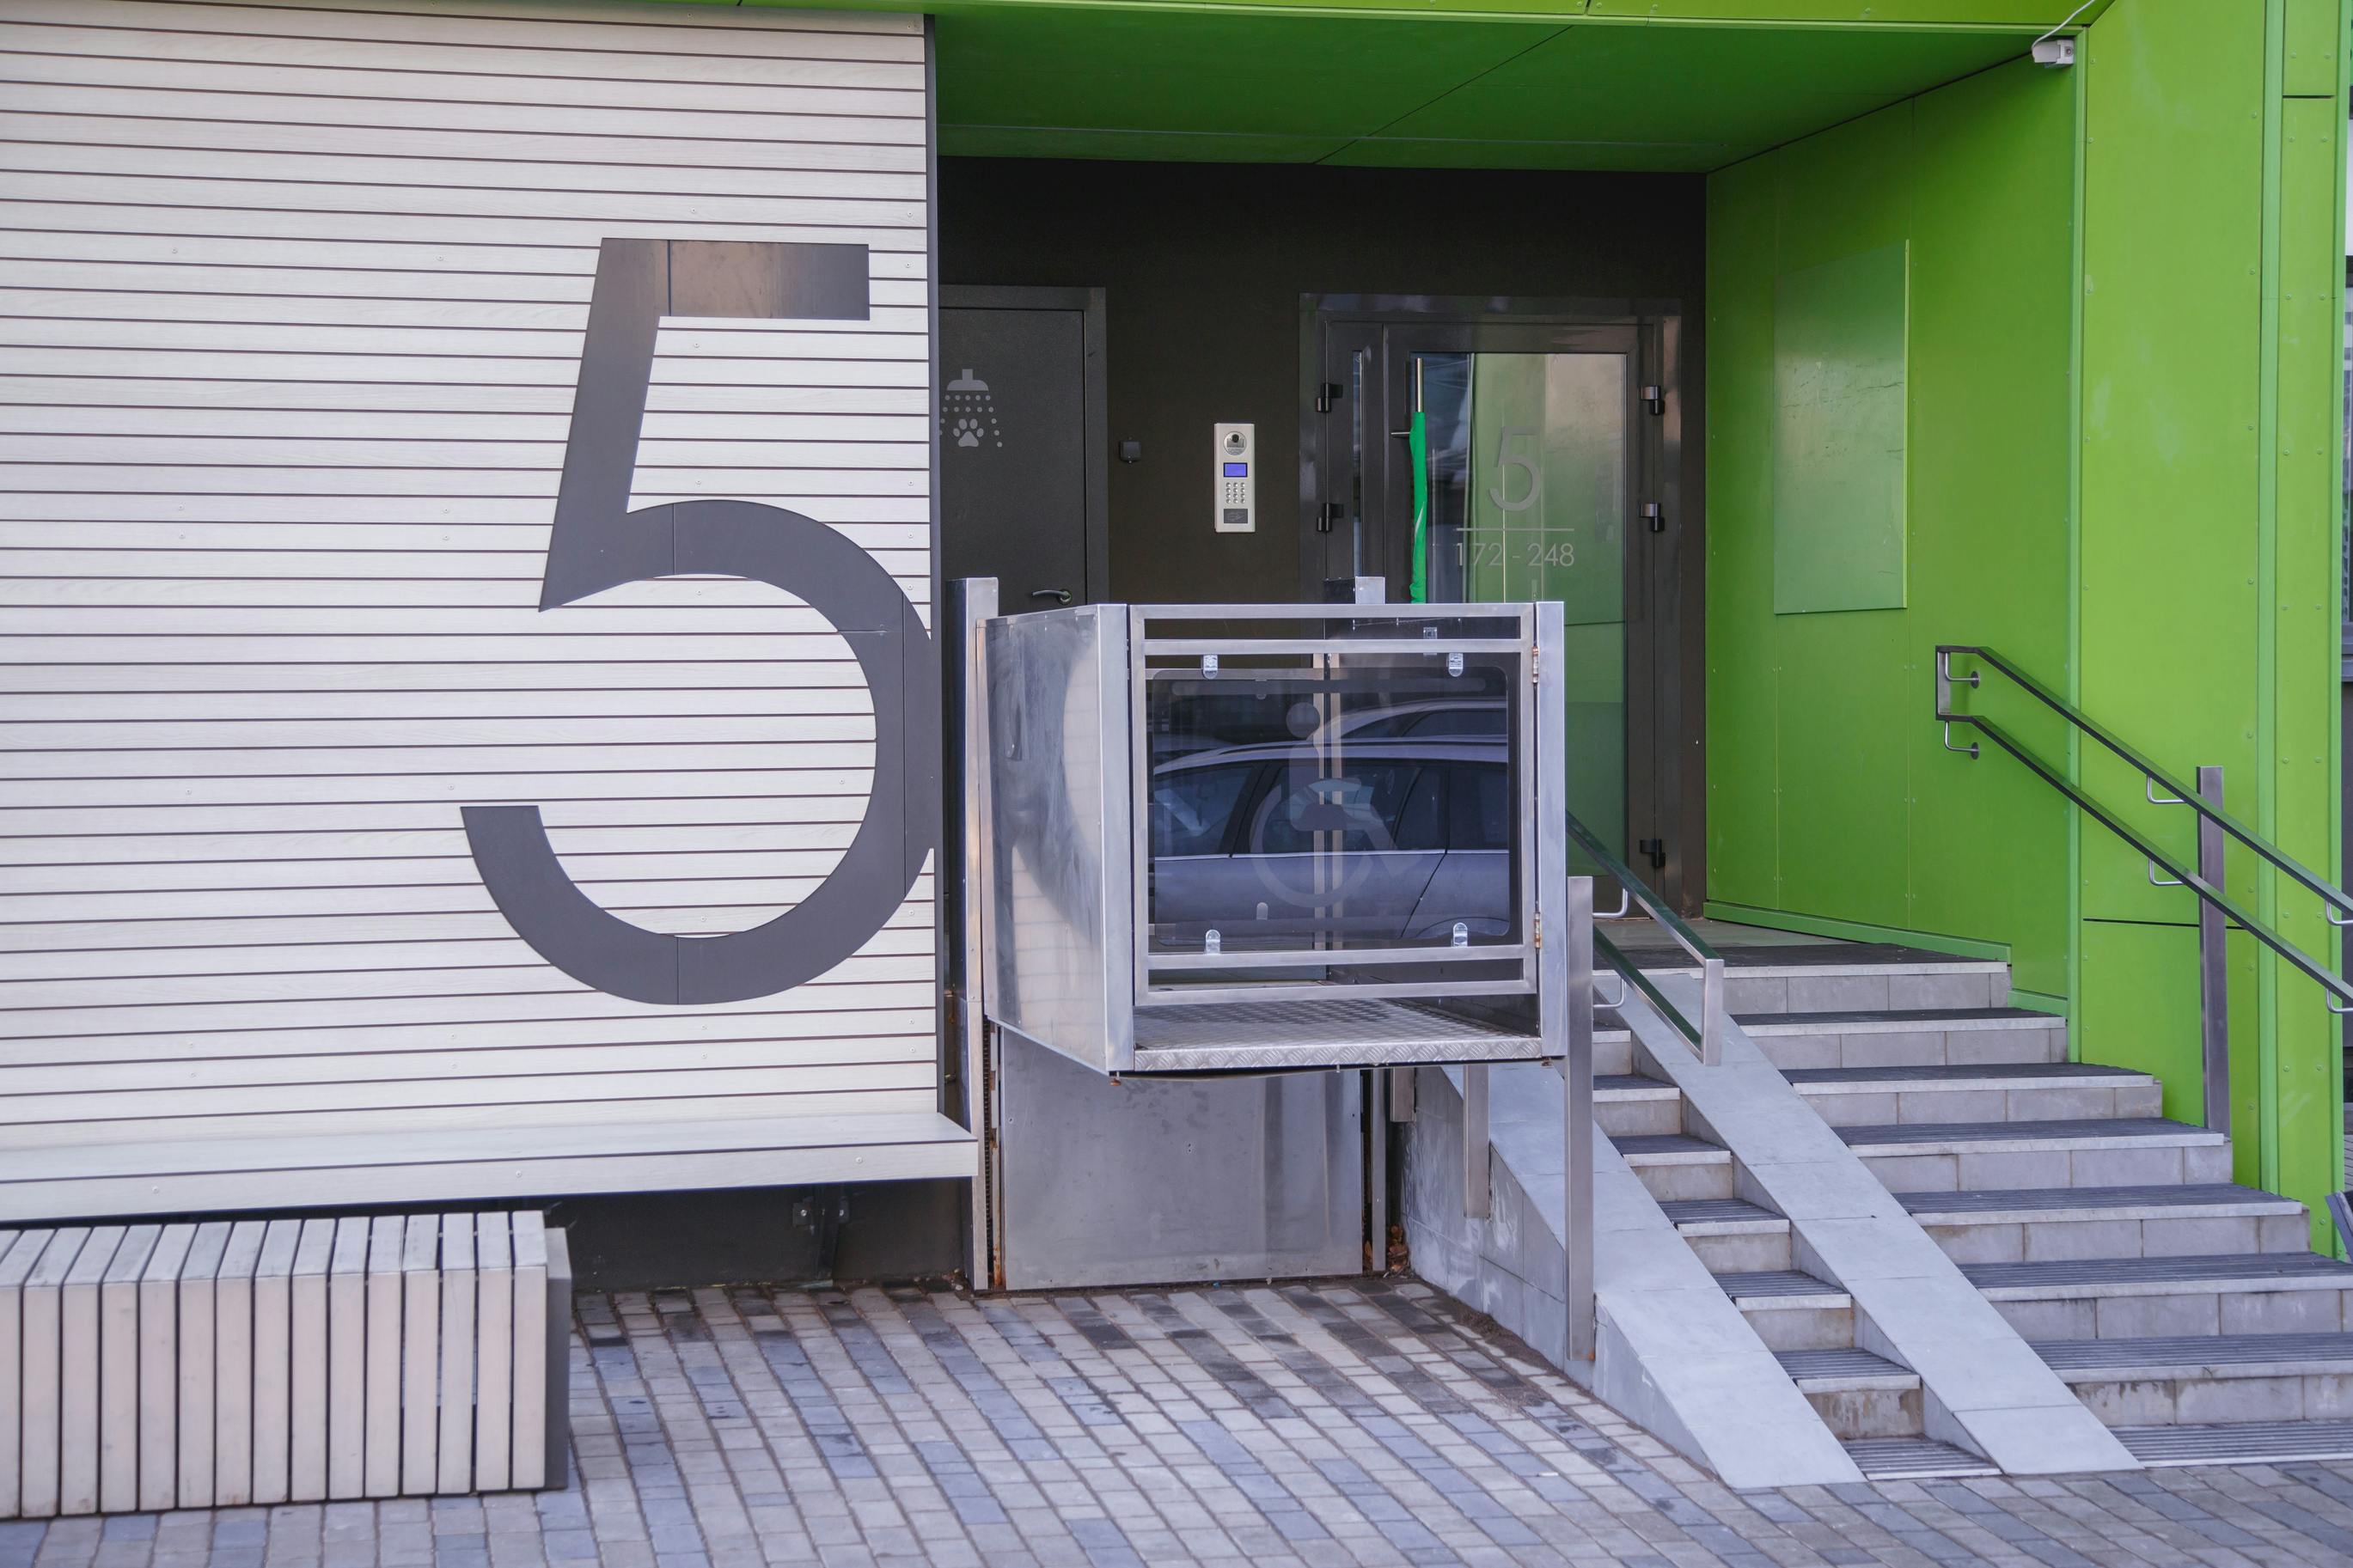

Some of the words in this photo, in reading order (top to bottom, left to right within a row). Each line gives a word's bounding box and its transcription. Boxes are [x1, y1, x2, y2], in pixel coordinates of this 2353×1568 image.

[1488, 426, 1542, 511] 5
[1456, 542, 1503, 567] 172
[1527, 542, 1575, 567] 248
[461, 237, 939, 1005] 5
